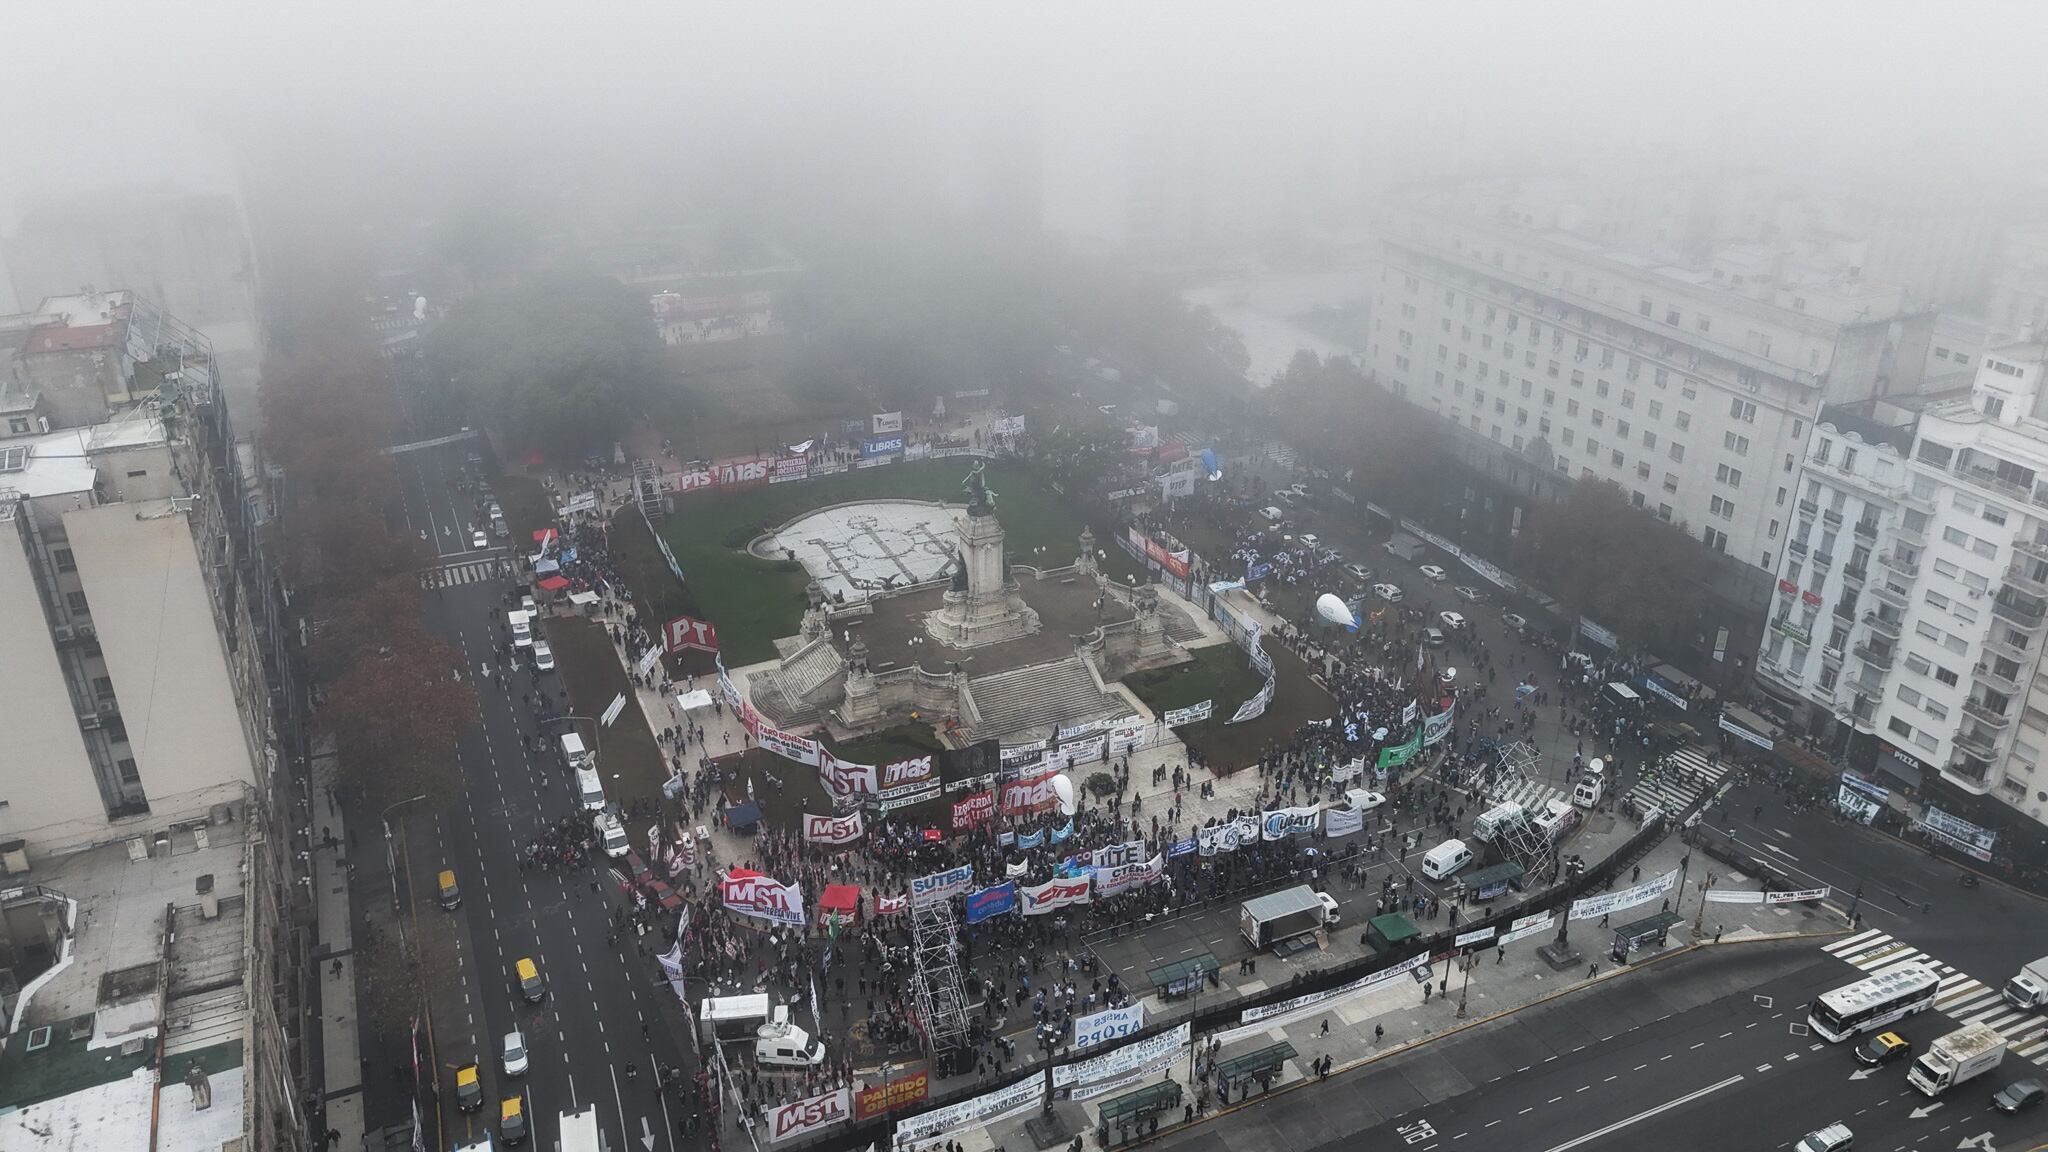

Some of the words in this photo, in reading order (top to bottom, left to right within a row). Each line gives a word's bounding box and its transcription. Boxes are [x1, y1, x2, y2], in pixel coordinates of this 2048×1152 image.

[870, 439, 902, 452] LIBRES
[681, 471, 711, 490] PTS
[672, 618, 716, 646] PT
[760, 724, 778, 737] PARO
[779, 732, 812, 749] GENERAL
[791, 742, 814, 755] lucha
[1894, 750, 1919, 769] PIZZA
[820, 753, 868, 794] MST
[884, 756, 931, 783] mas
[812, 820, 858, 841] MST
[1280, 812, 1318, 830] UGATT
[914, 866, 972, 893] SUTEBA
[1112, 863, 1152, 878] CTERA
[729, 883, 787, 909] MST
[880, 894, 907, 910] PTS
[1036, 883, 1088, 905] CTA
[763, 905, 785, 919] TERESA
[784, 911, 801, 921] VIVE
[863, 1076, 927, 1104] PARTIDO
[865, 1087, 925, 1113] OBRERO
[782, 1099, 839, 1131] MST
[1397, 1119, 1437, 1144] BUS
